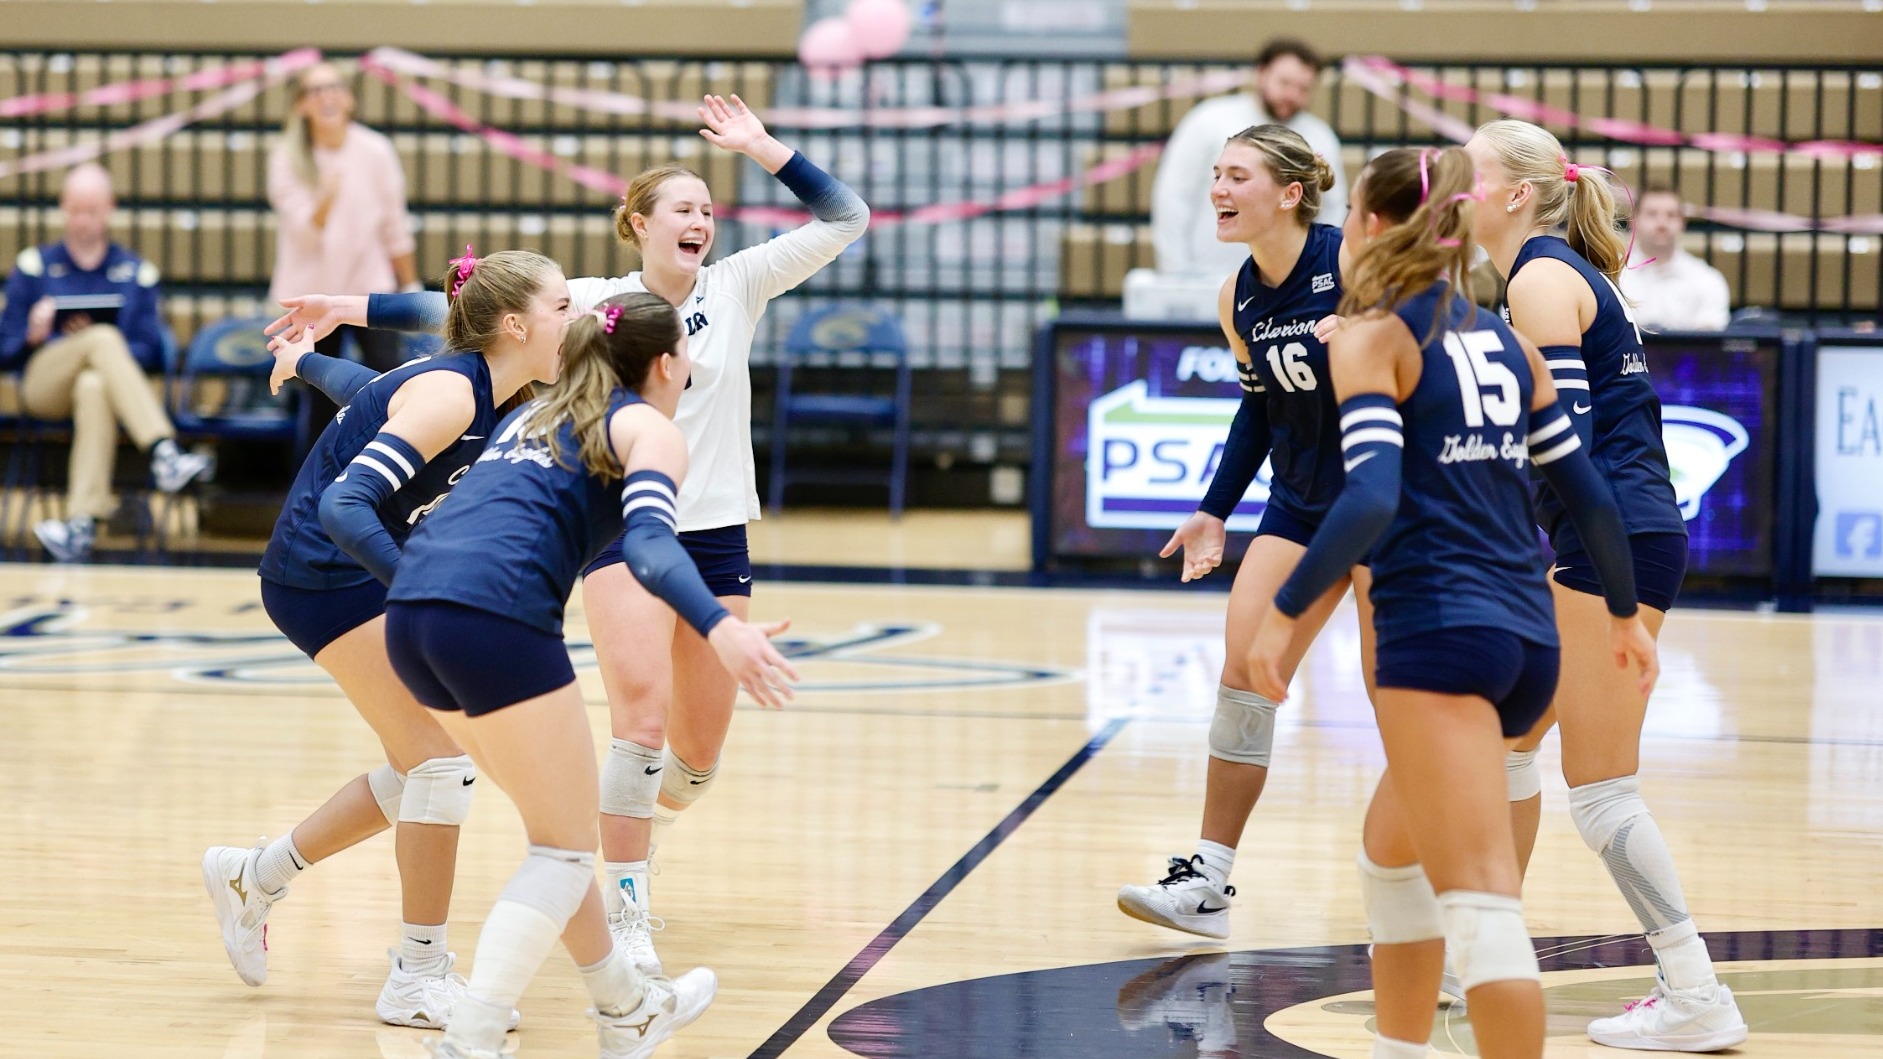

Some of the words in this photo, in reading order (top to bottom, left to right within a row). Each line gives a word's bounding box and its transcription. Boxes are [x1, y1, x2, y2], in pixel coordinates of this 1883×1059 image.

[1252, 317, 1316, 342] Clarion
[1266, 342, 1317, 393] 16
[1443, 329, 1521, 427] 15
[1438, 433, 1499, 464] Golden
